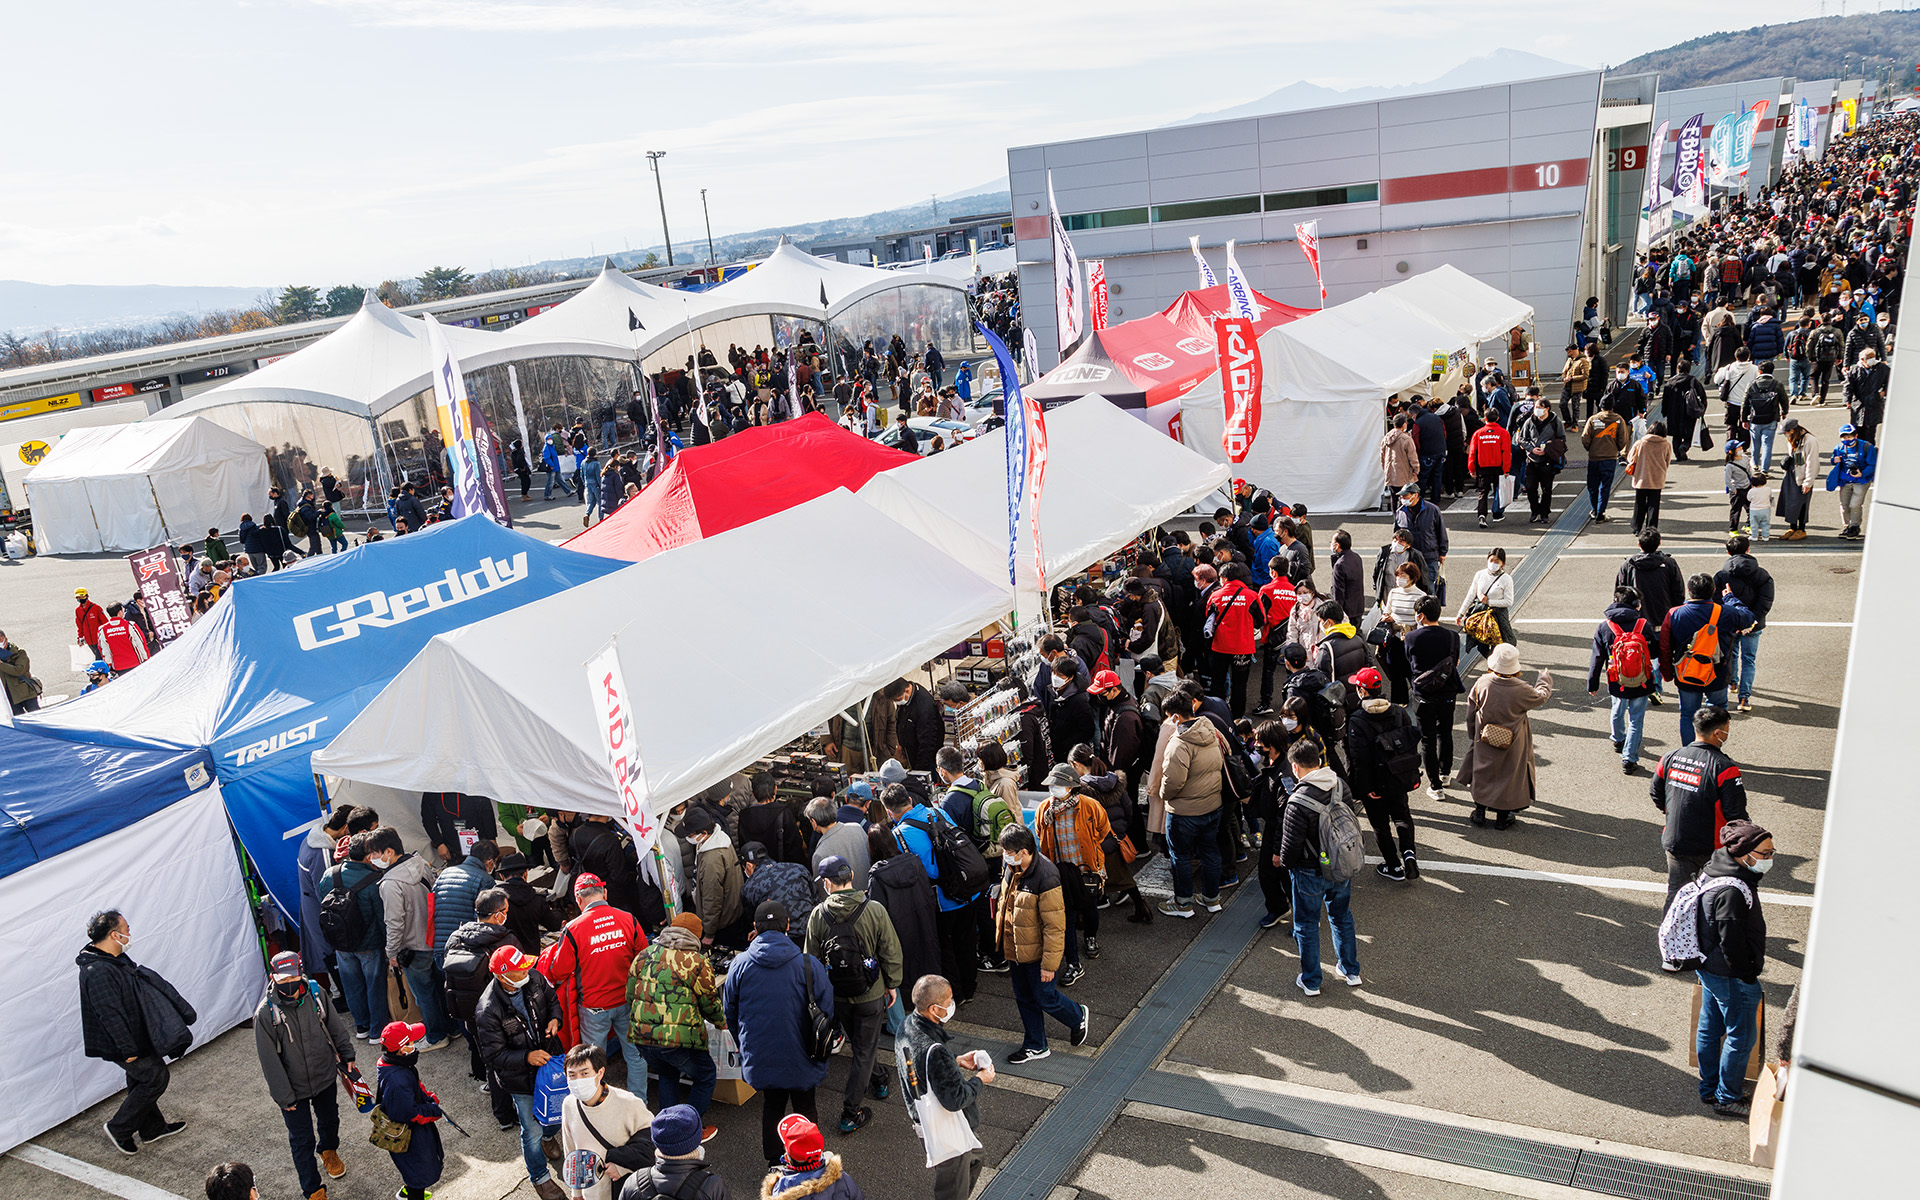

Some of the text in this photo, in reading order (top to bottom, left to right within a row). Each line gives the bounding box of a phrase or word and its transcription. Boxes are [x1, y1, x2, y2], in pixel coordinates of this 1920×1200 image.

[1777, 117, 1785, 127] 7
[1623, 149, 1637, 169] 9
[1678, 125, 1700, 191] EBBRO
[1535, 164, 1560, 188] 10
[1179, 338, 1211, 354] TONE
[1136, 354, 1172, 369] TONE
[214, 367, 229, 377] IDI
[1055, 366, 1107, 382] TONE
[292, 551, 529, 651] GReddy
[106, 626, 126, 634] MOTUL
[603, 672, 624, 750] KID
[224, 716, 328, 767] TRUST
[1672, 756, 1706, 768] NISSAN
[1669, 770, 1699, 784] MOTUL
[593, 915, 614, 924] NISSAN
[590, 929, 624, 945] MOTUL
[590, 940, 626, 955] AUTECH
